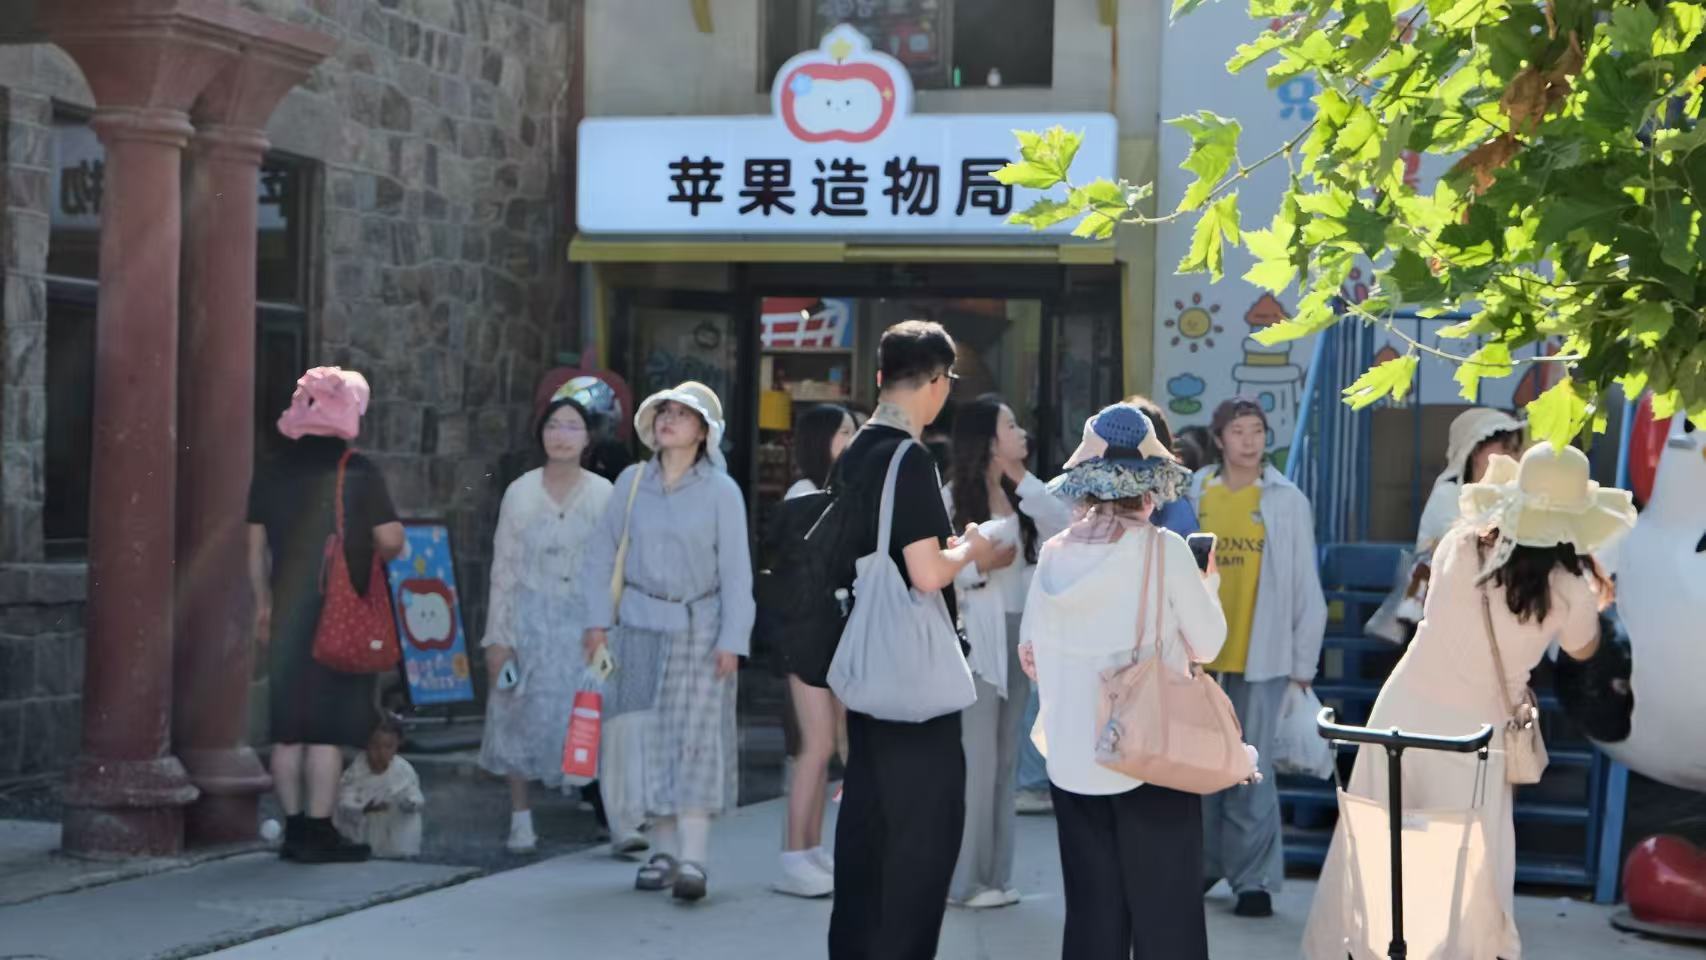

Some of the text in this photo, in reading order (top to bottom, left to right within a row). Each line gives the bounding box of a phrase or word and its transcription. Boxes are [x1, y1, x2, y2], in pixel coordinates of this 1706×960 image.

[667, 156, 1014, 216] 苹果造物局
